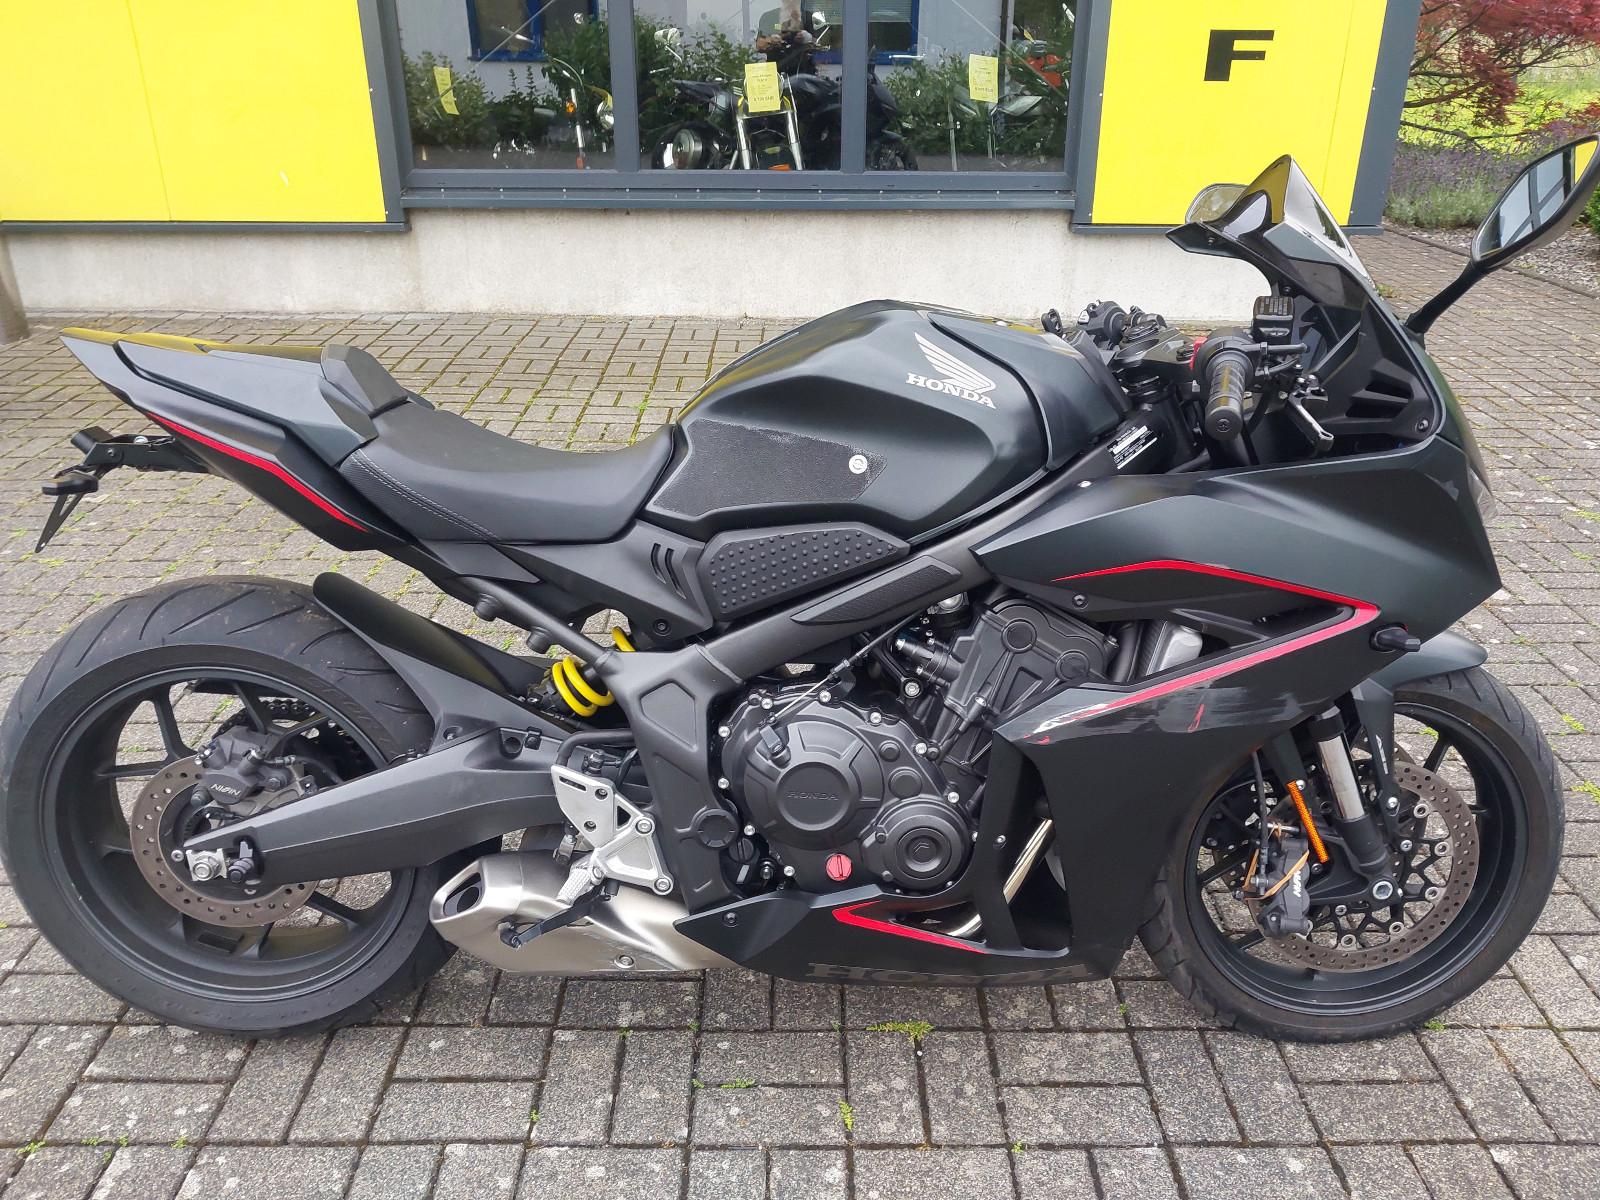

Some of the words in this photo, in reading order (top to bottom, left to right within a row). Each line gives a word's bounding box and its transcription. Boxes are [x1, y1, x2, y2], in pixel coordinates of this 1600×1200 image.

[1204, 29, 1274, 81] F
[906, 372, 997, 409] HONDA
[785, 791, 839, 801] HONDA
